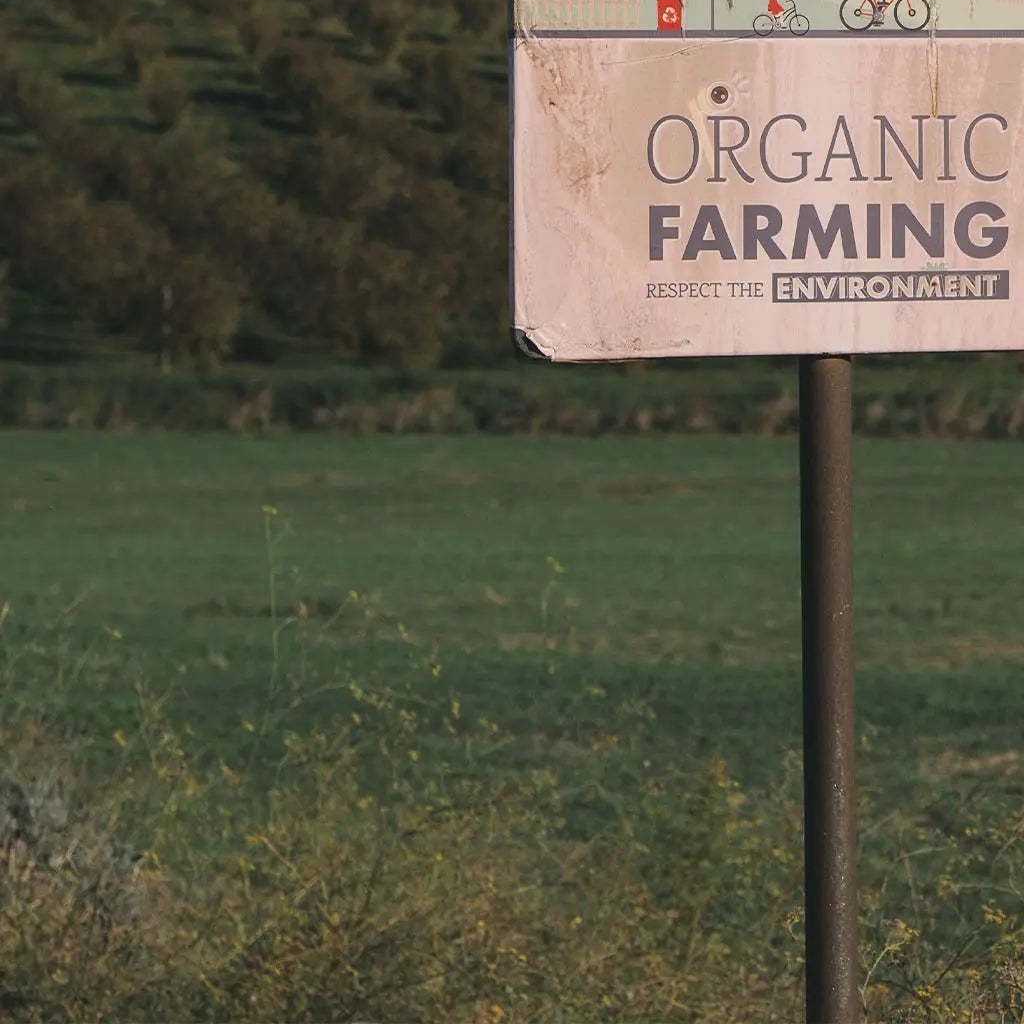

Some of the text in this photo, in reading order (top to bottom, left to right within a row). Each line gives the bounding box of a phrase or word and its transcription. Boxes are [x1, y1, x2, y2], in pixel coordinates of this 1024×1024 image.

[647, 113, 1009, 184] ORGANIC
[648, 201, 1009, 261] FARMING
[646, 274, 1000, 301] RESPECT THE ENVIRONMENT
